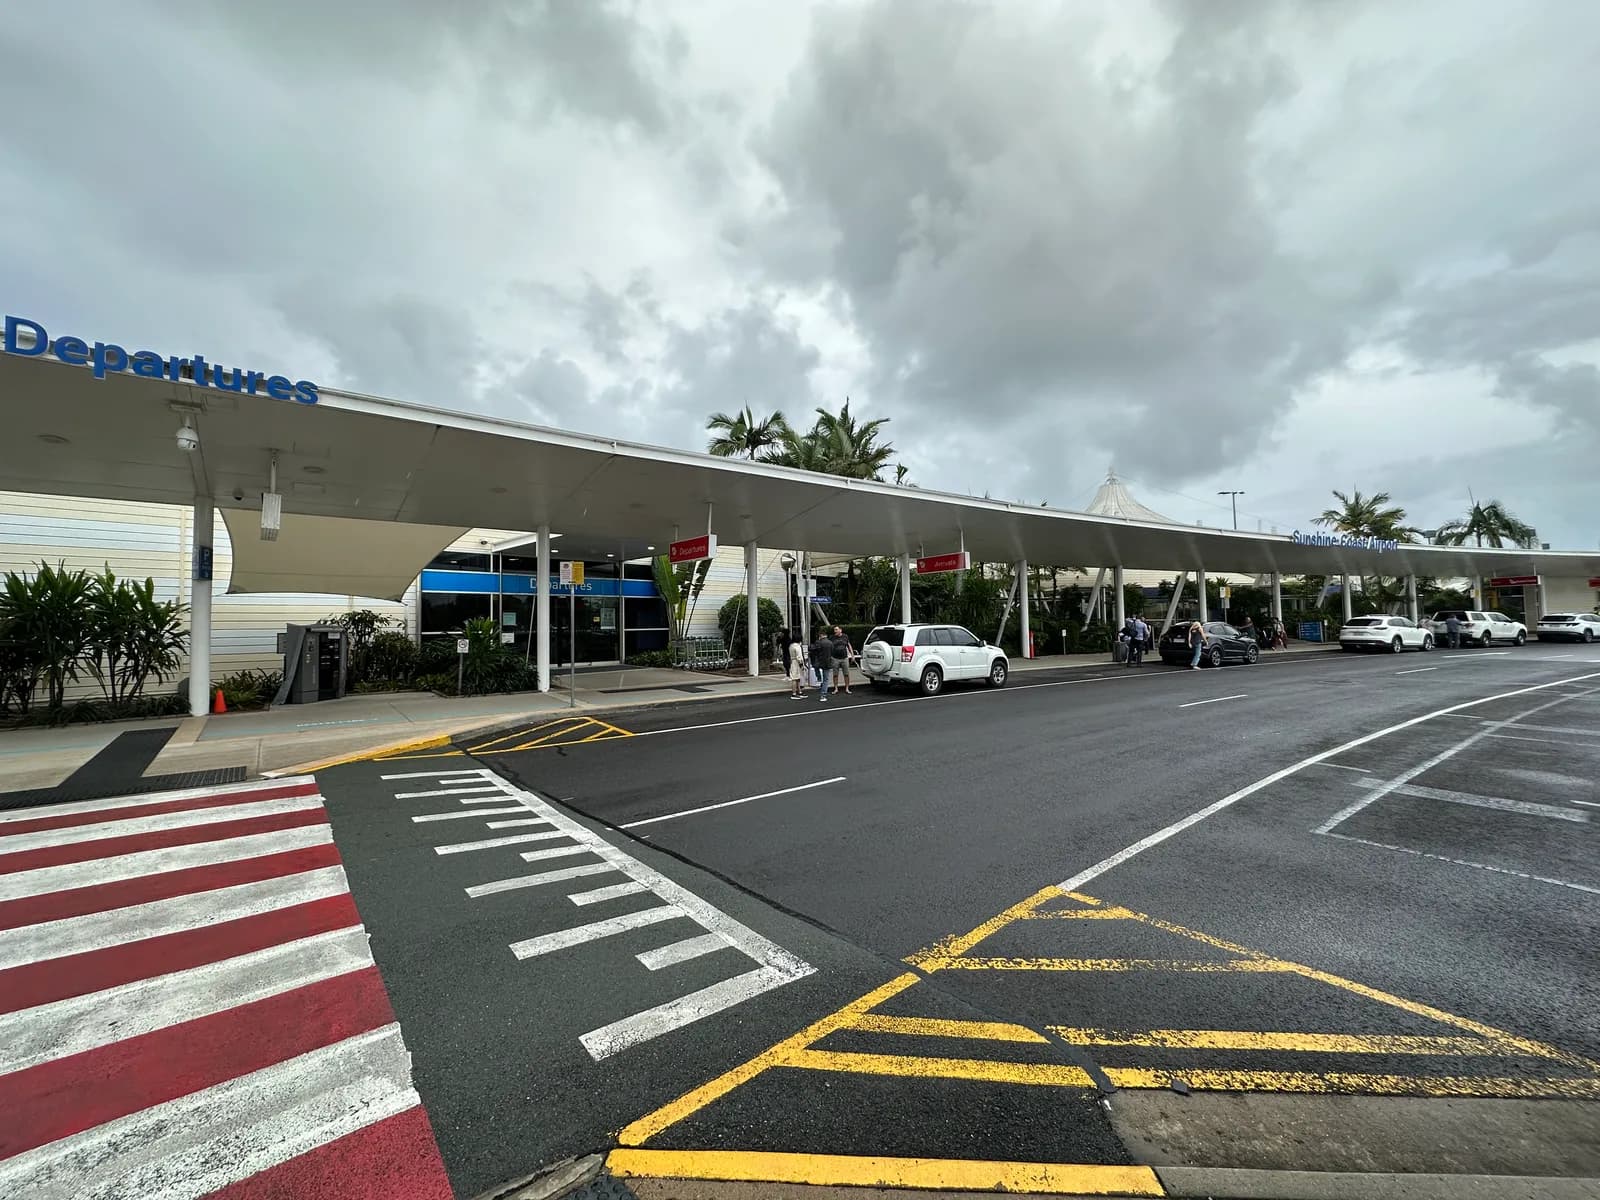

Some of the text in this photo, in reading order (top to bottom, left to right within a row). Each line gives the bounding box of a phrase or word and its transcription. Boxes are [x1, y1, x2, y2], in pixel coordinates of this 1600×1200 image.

[5, 315, 319, 405] Departures
[1293, 529, 1337, 546] Sunshine
[680, 541, 706, 556] Departures
[530, 577, 592, 591] Dartres
